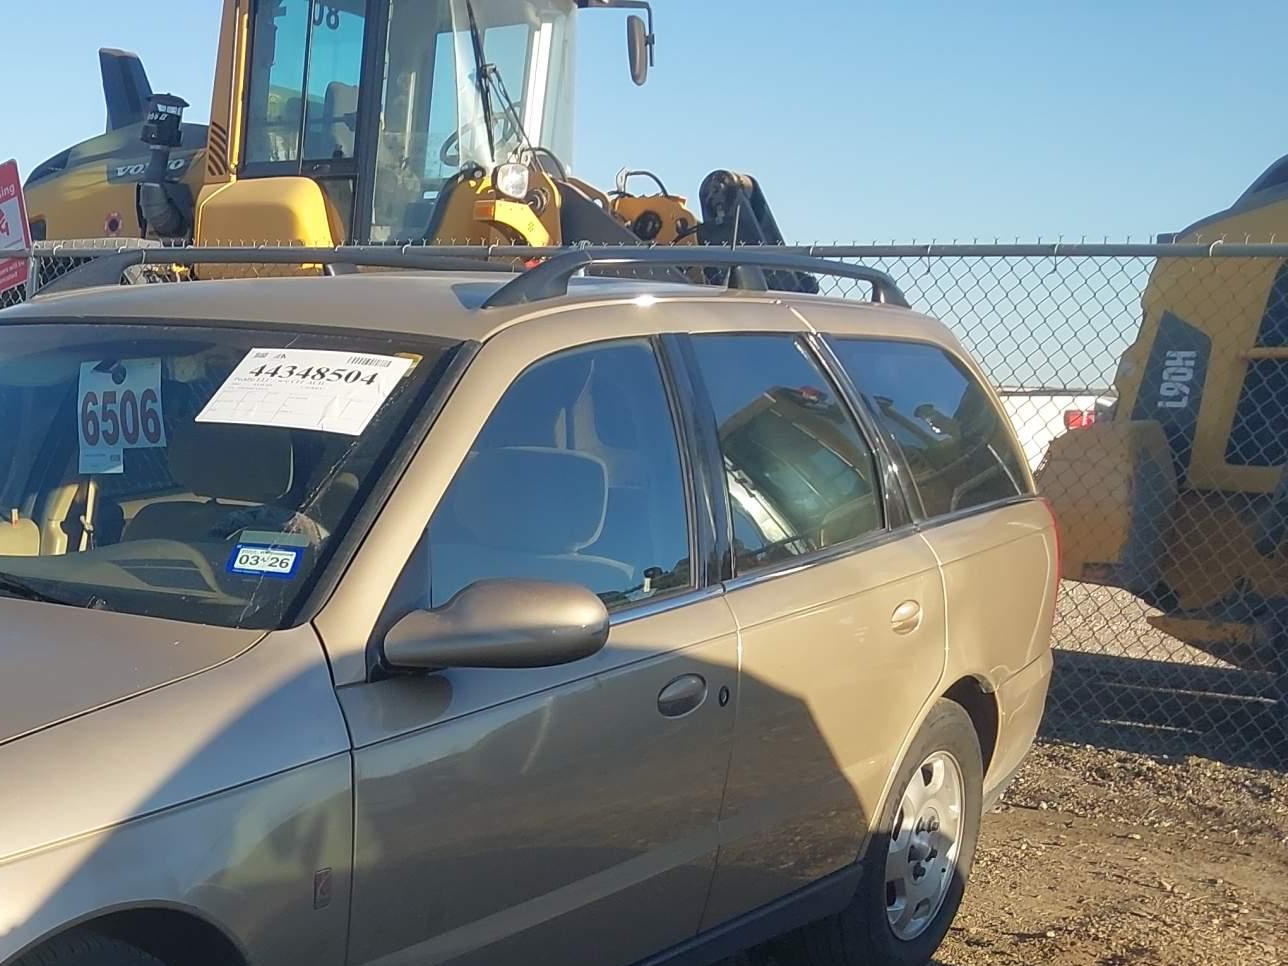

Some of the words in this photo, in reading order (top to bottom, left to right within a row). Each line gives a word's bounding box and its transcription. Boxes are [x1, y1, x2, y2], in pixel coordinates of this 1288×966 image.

[249, 364, 378, 385] 44348504
[1157, 350, 1197, 408] L90H
[81, 389, 161, 446] 6506
